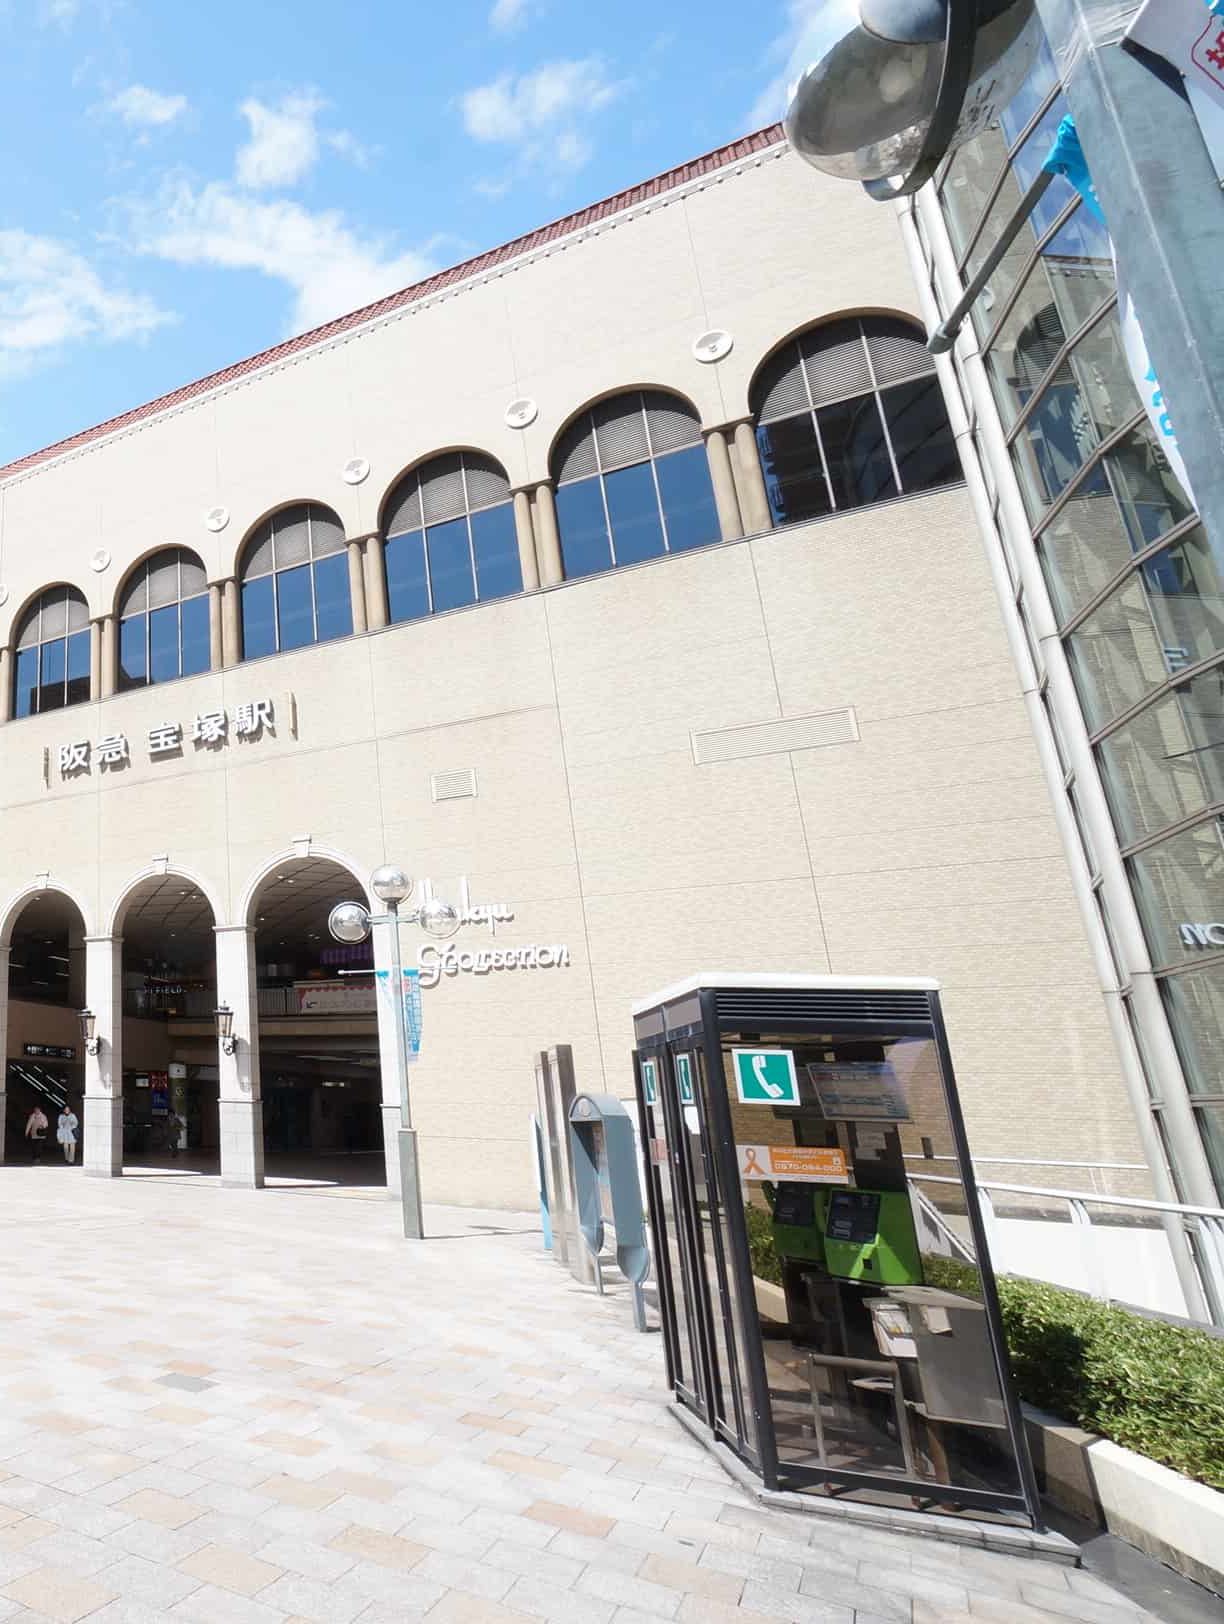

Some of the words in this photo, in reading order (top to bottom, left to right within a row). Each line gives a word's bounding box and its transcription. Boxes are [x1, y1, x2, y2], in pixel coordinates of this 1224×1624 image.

[58, 735, 129, 771] 阪急
[147, 698, 274, 754] 宝塚駅
